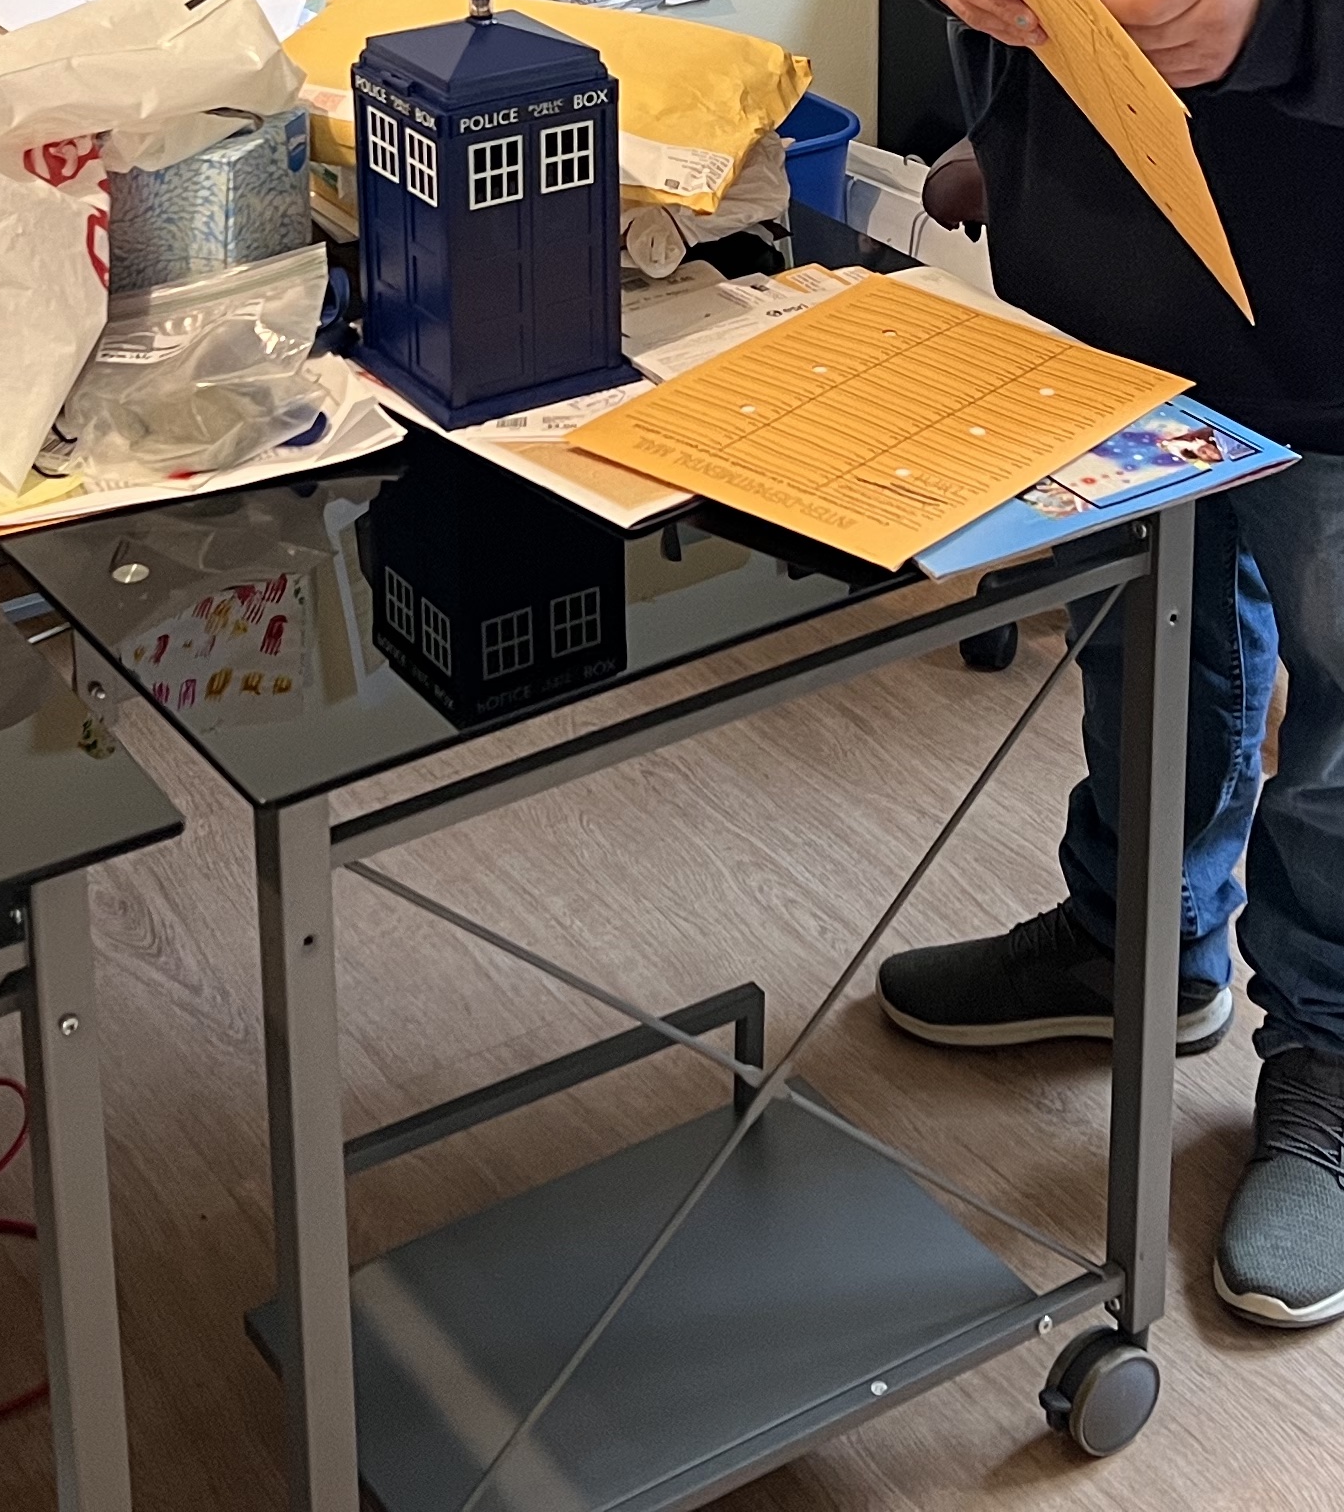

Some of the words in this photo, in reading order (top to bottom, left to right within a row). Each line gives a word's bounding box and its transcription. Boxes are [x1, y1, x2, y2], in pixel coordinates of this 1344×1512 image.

[355, 75, 387, 104] POLICE
[414, 106, 437, 131] BOX
[459, 107, 519, 134] POLICE
[573, 88, 609, 110] BOX
[527, 98, 564, 114] PUBLIC
[534, 105, 560, 116] CALL
